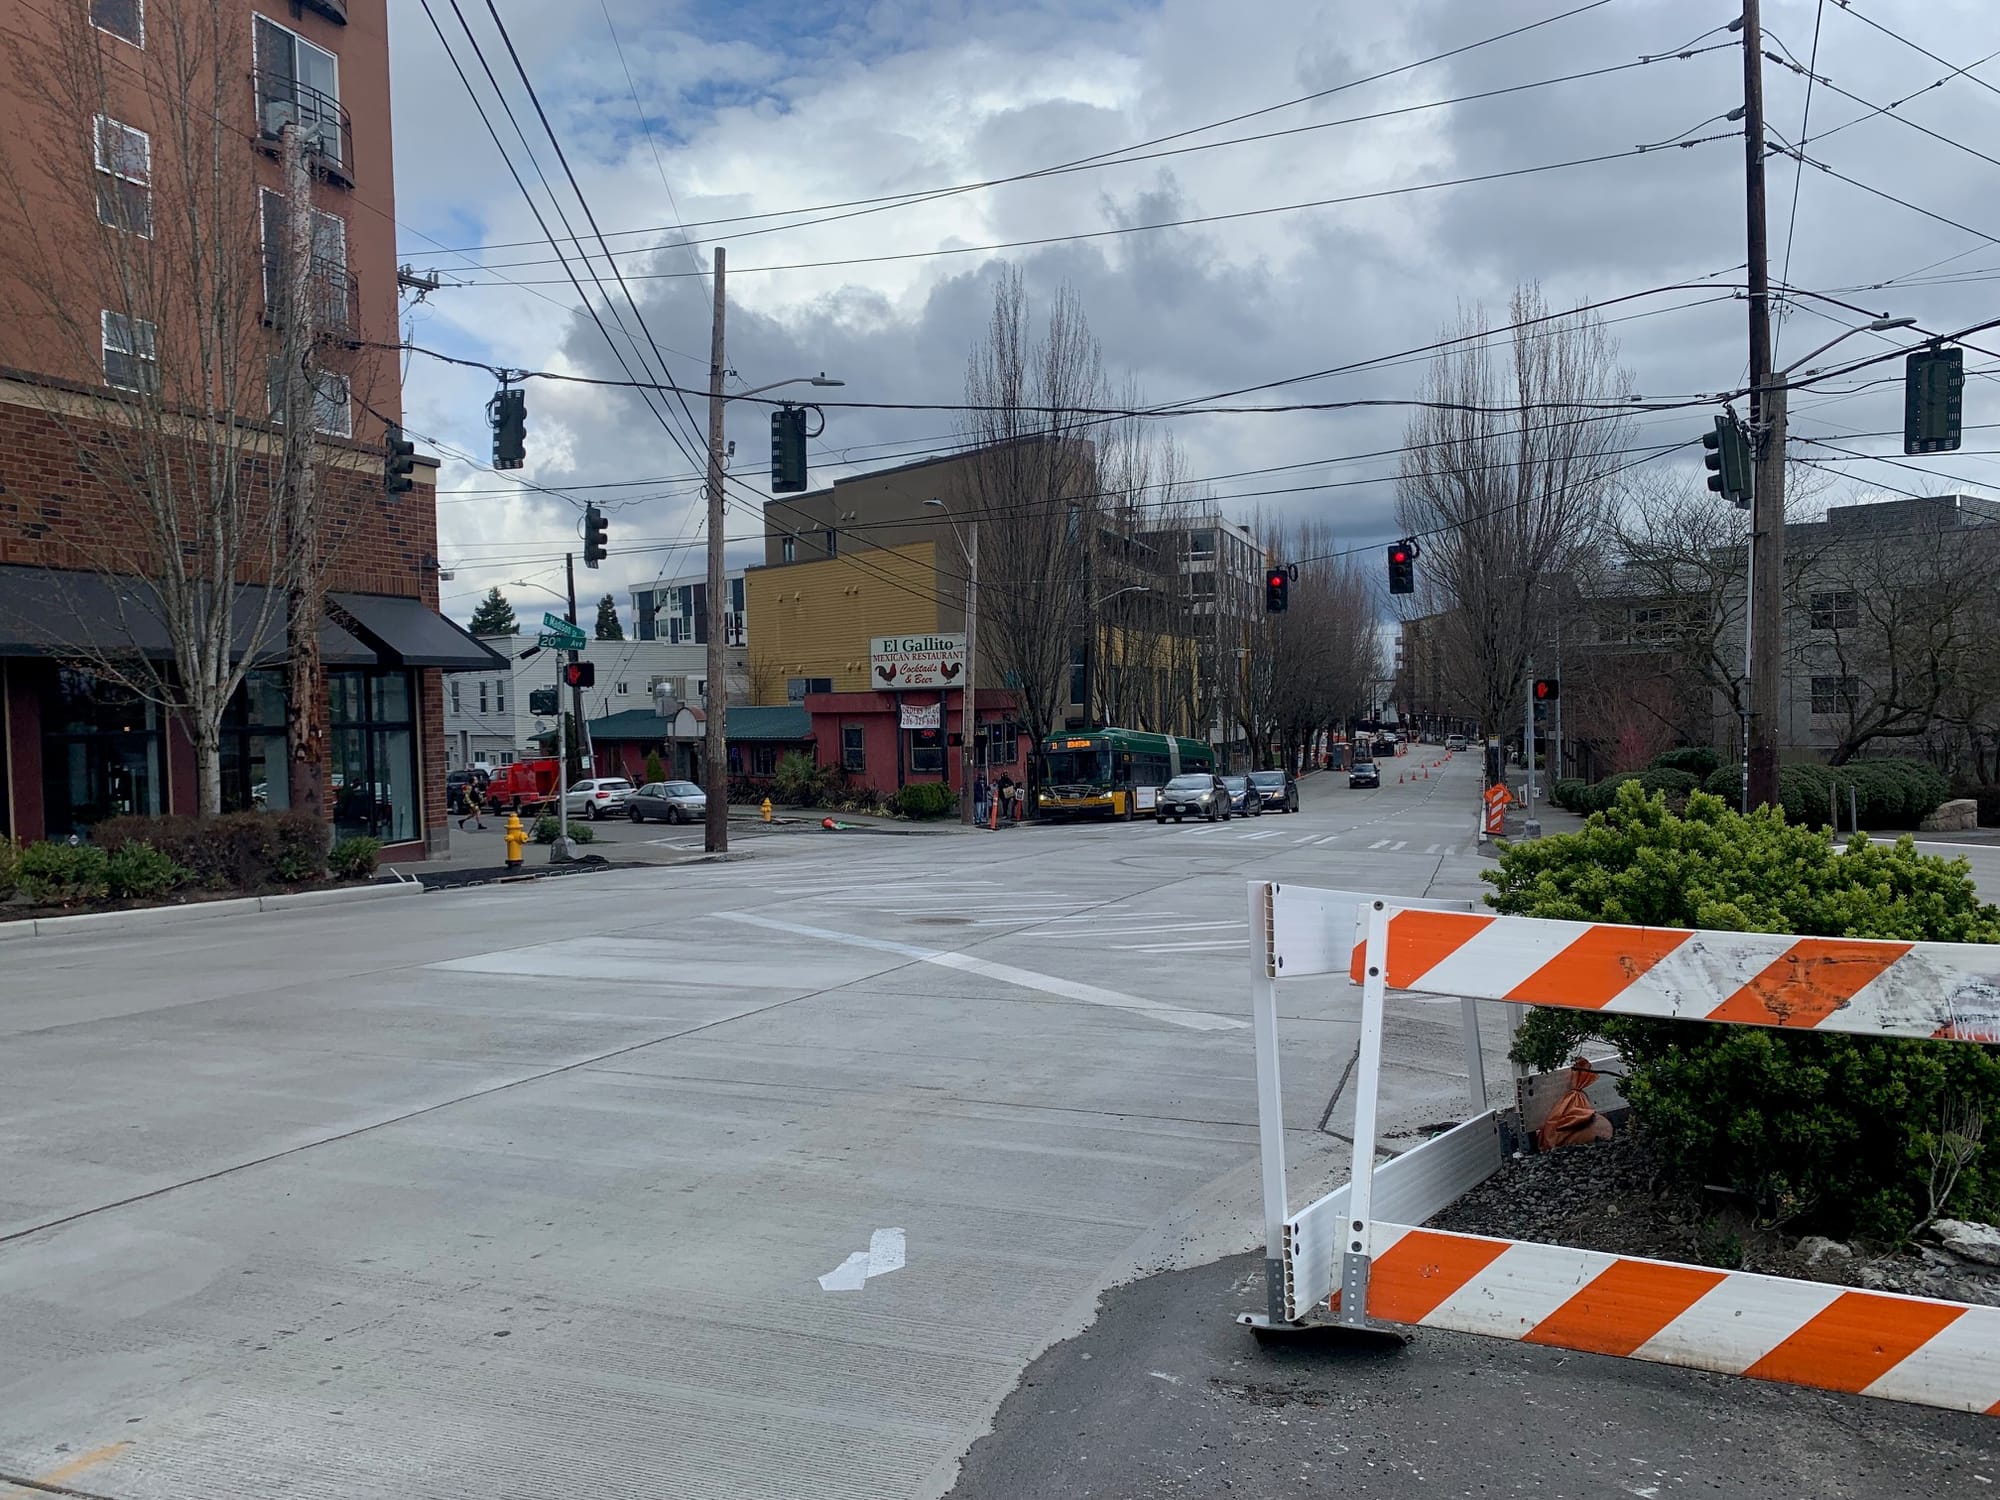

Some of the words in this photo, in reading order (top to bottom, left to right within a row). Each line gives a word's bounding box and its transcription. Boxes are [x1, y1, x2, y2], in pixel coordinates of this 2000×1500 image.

[549, 616, 571, 634] Madison
[883, 639, 898, 653] El
[902, 638, 954, 652] Gallito
[873, 653, 910, 662] MEXICAN
[912, 651, 964, 661] RESTAURANT
[900, 663, 937, 675] Cocktails
[905, 674, 912, 684] &
[914, 674, 933, 684] Beer
